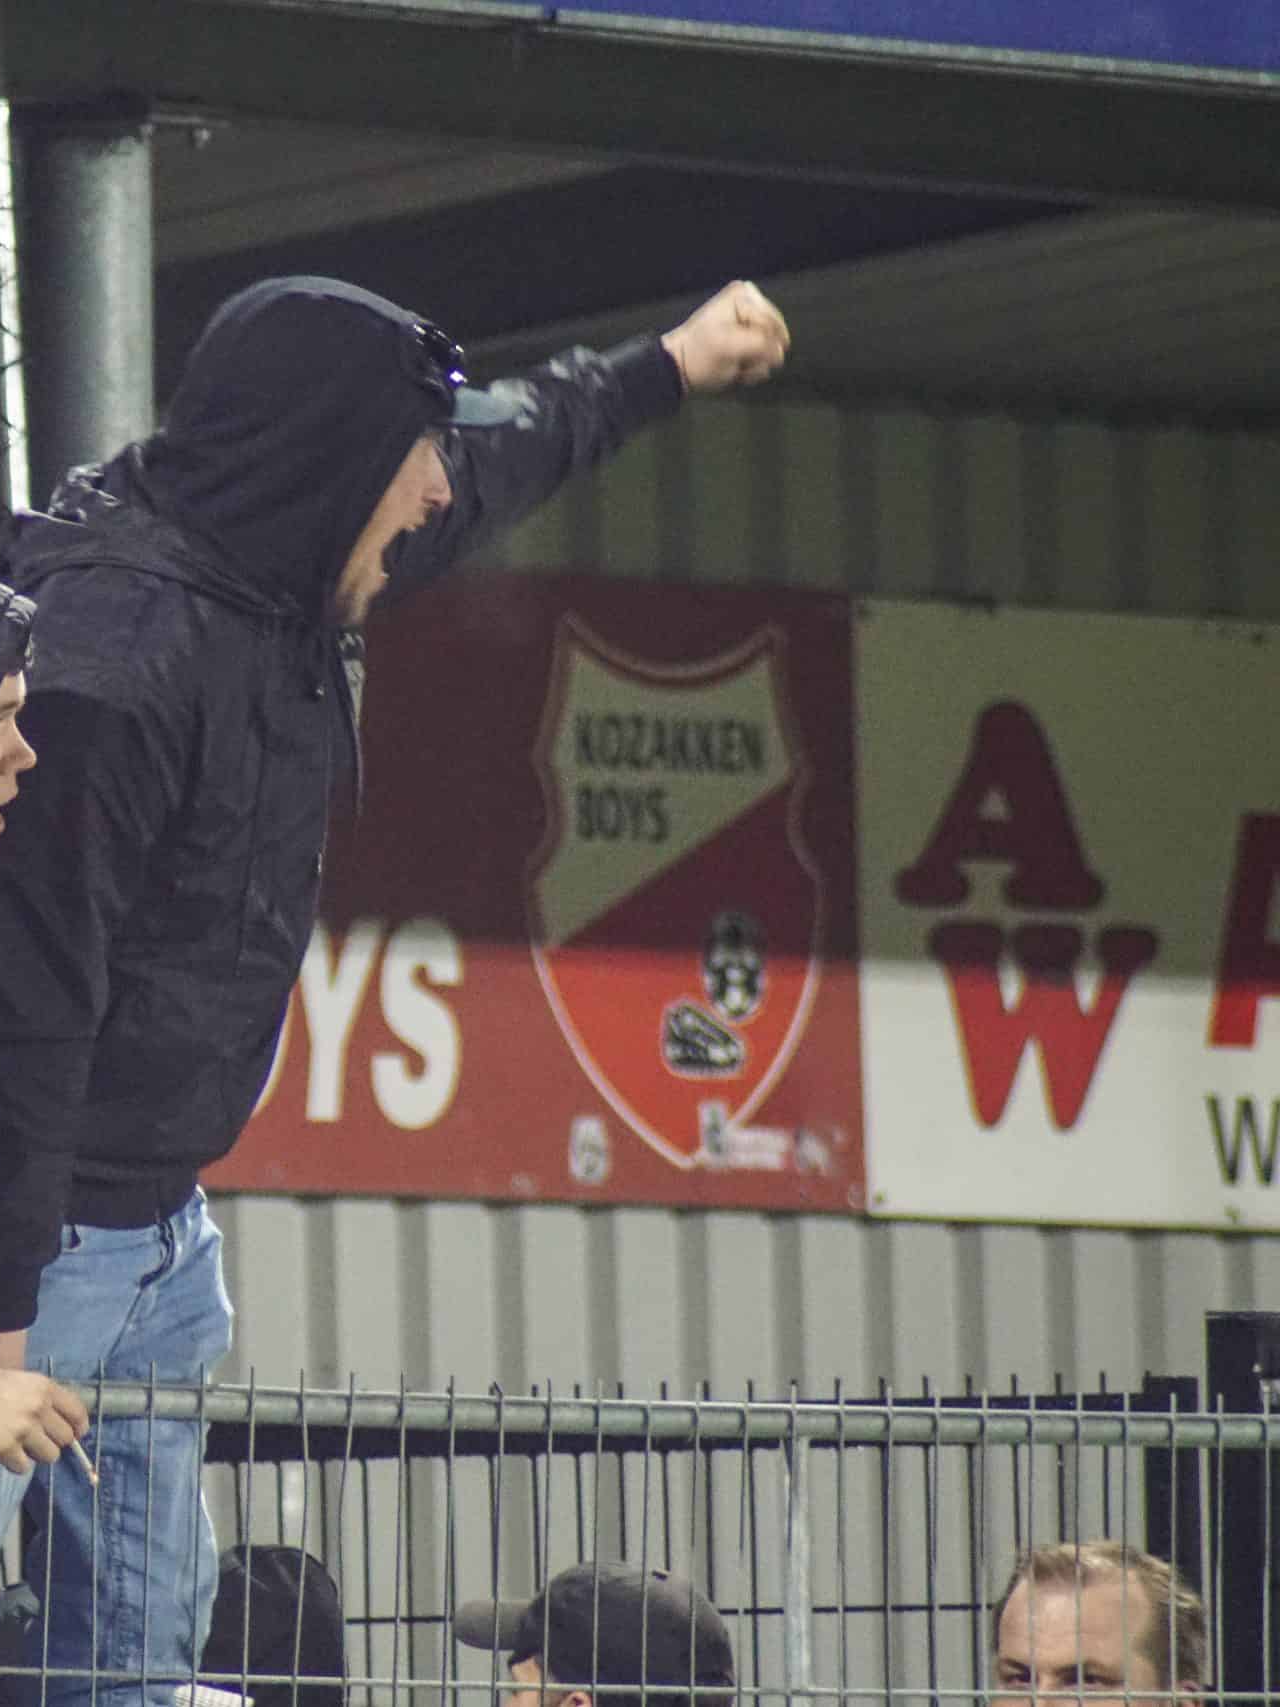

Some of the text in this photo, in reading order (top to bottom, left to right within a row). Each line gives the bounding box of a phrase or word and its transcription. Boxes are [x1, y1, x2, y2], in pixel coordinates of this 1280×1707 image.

[575, 713, 766, 774] KOZAKKEN
[577, 783, 669, 844] BOYS
[250, 915, 466, 1130] YS
